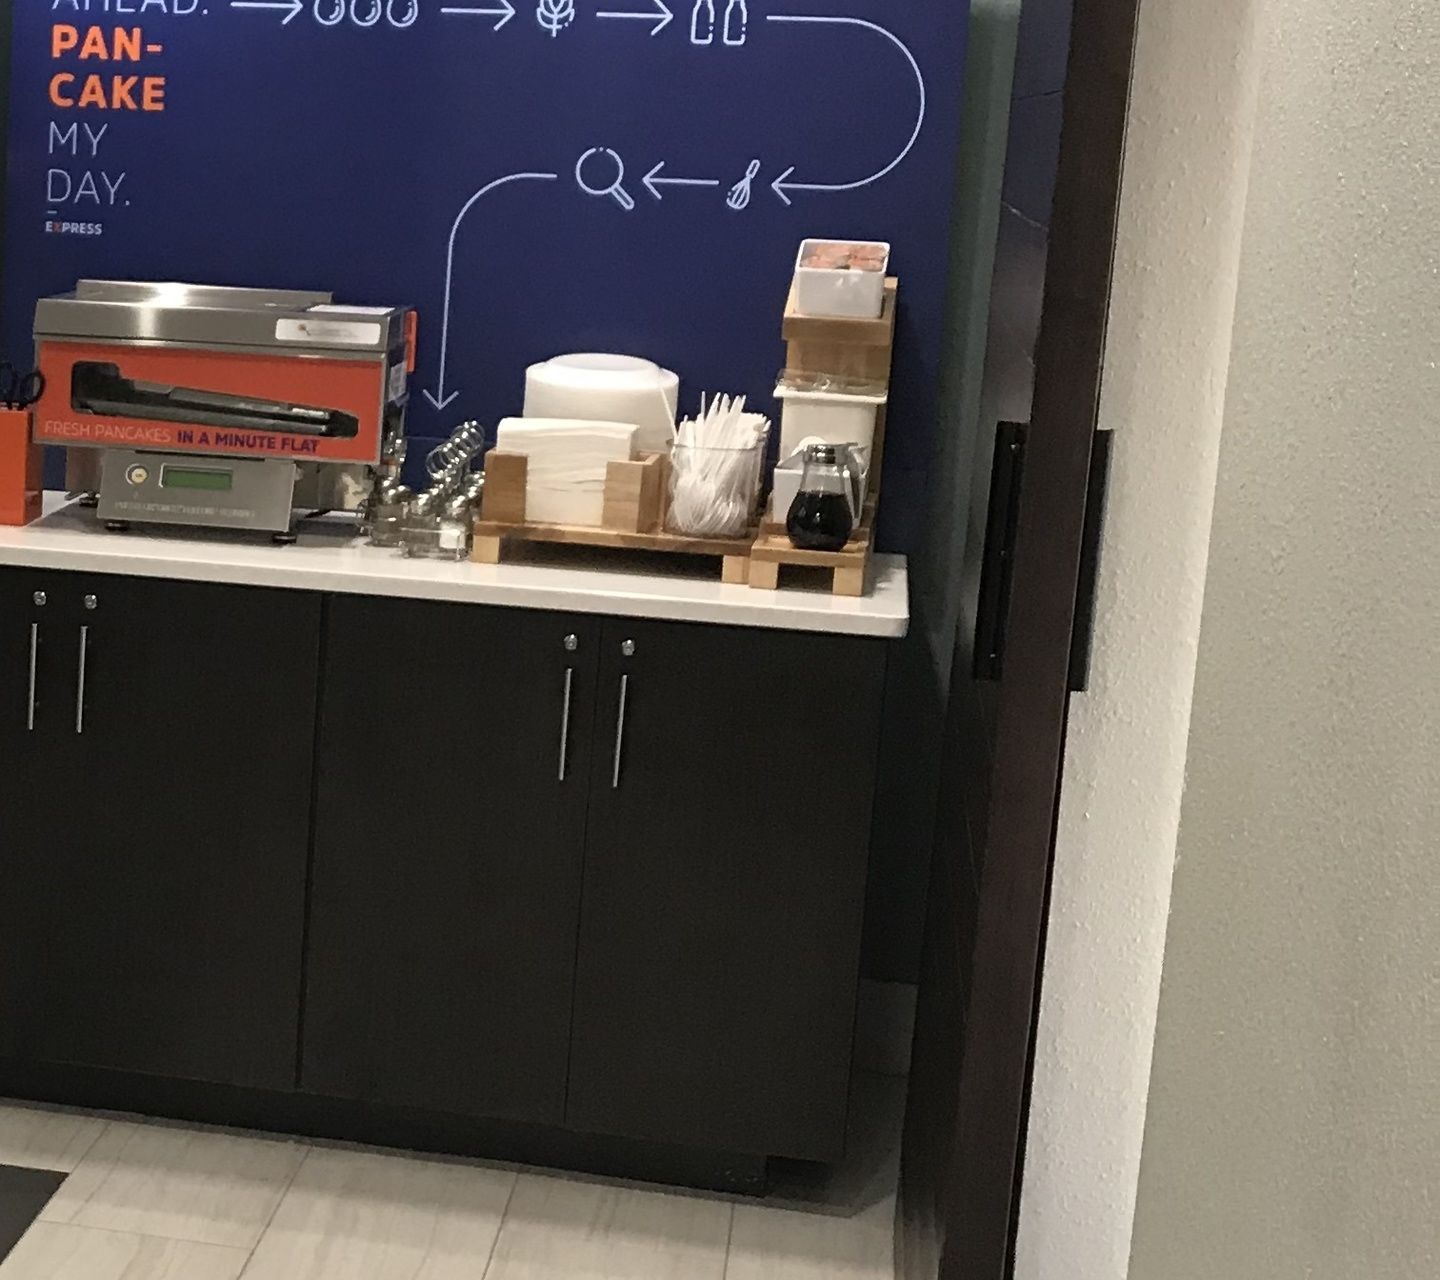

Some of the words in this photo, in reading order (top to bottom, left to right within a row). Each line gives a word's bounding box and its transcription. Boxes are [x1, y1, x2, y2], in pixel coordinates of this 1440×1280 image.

[51, 24, 163, 61] PAN-
[48, 72, 166, 111] CAKE
[49, 121, 108, 155] MY
[47, 168, 130, 205] DAY.
[45, 221, 102, 235] EXPRESS
[44, 420, 92, 437] FRESH
[94, 423, 173, 443] PANCAKES
[177, 430, 195, 444] IN
[197, 431, 211, 445] A
[215, 432, 277, 450] MINUTE
[281, 436, 321, 454] FLAT
